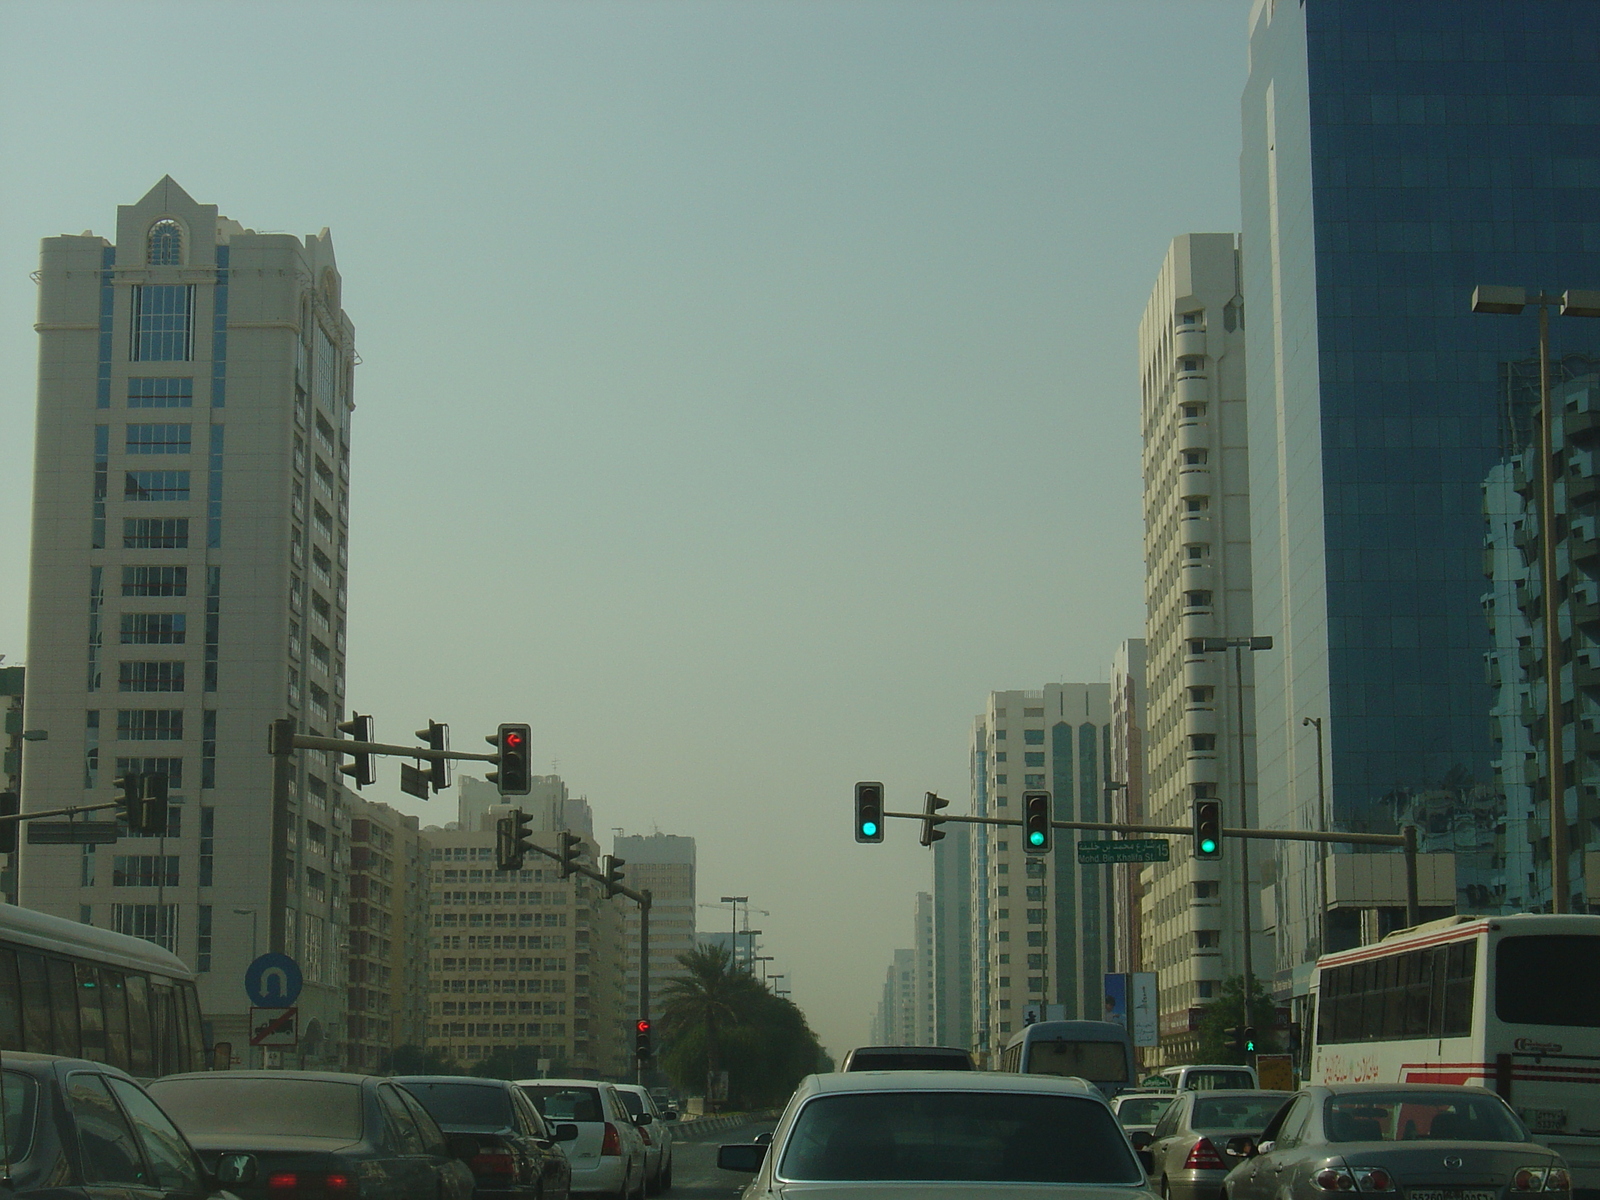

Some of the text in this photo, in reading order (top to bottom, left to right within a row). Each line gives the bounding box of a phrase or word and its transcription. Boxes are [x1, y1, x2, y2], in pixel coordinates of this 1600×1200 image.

[1156, 844, 1168, 857] 15
[1102, 854, 1114, 862] Bin
[1117, 853, 1143, 861] Khalifa
